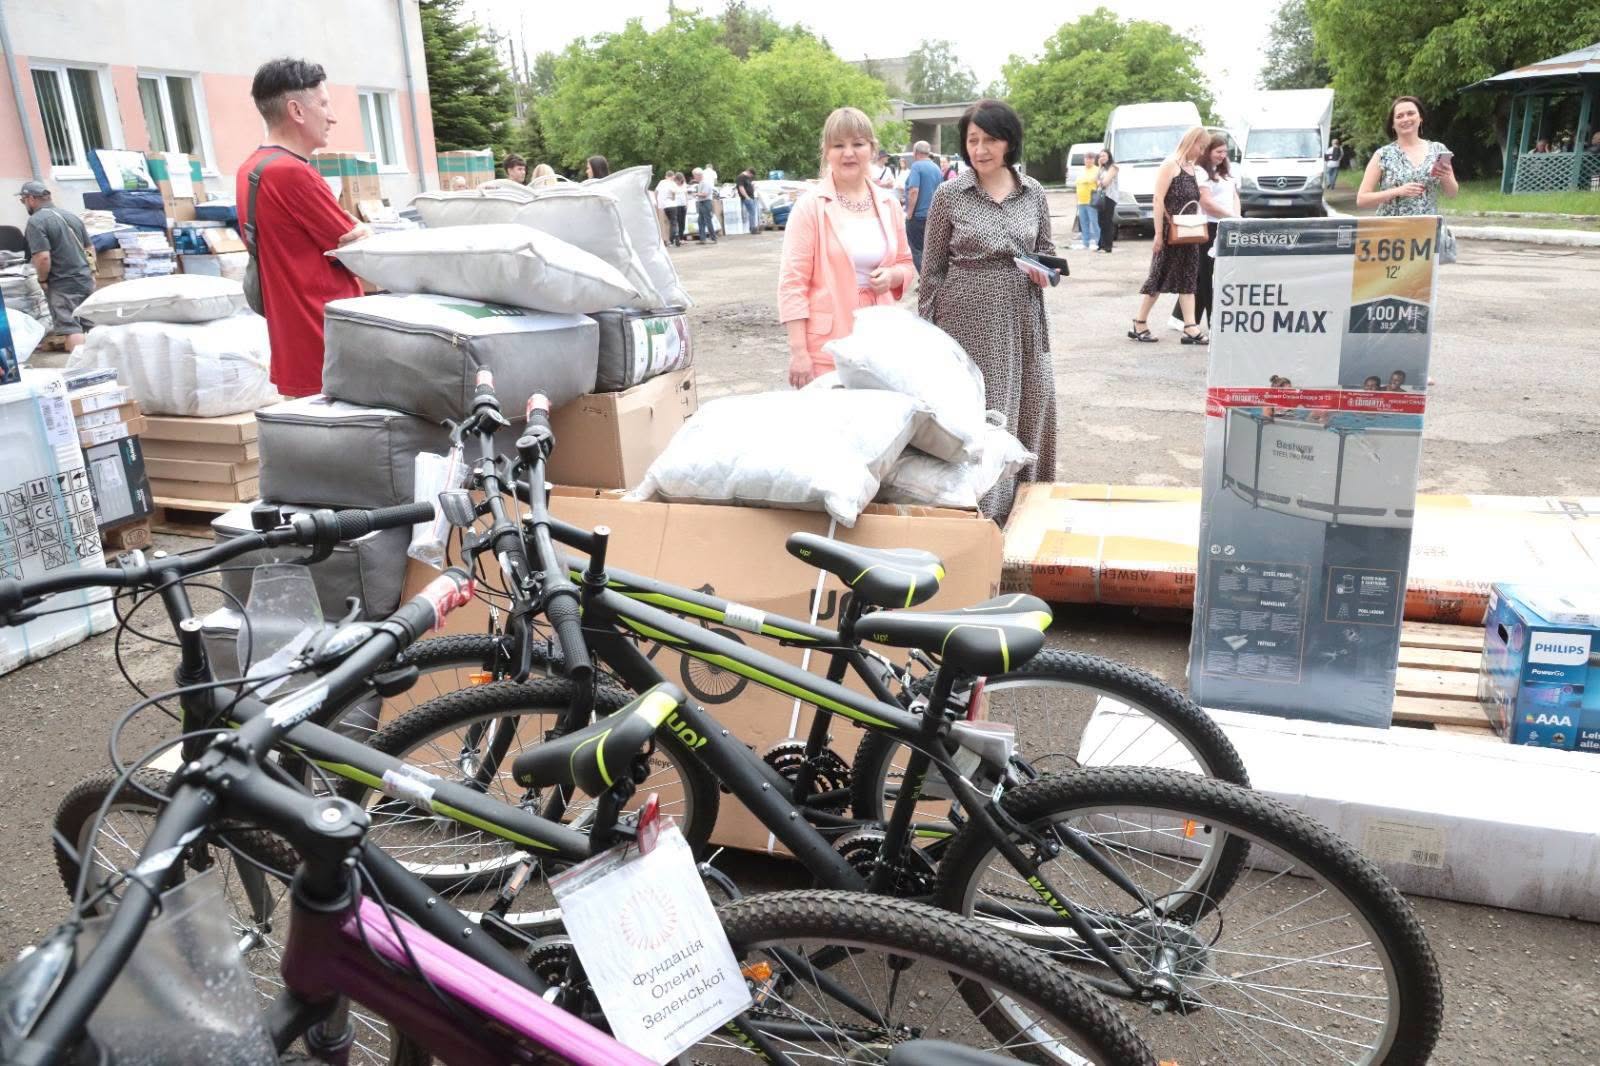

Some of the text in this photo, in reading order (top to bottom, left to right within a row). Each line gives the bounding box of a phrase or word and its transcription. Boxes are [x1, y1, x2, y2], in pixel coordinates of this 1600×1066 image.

[1227, 231, 1299, 249] Bestway
[1358, 237, 1431, 263] 3.66 M
[1220, 283, 1289, 306] STEEL
[1220, 310, 1327, 333] PRO MAX
[1366, 305, 1394, 321] 1.00
[1535, 642, 1585, 655] PHILIPS
[1531, 668, 1565, 677] PowerGo
[1535, 713, 1573, 727] AAA
[632, 939, 704, 987] Фундація
[651, 963, 701, 999] Олени
[642, 967, 726, 1030] Зеленської
